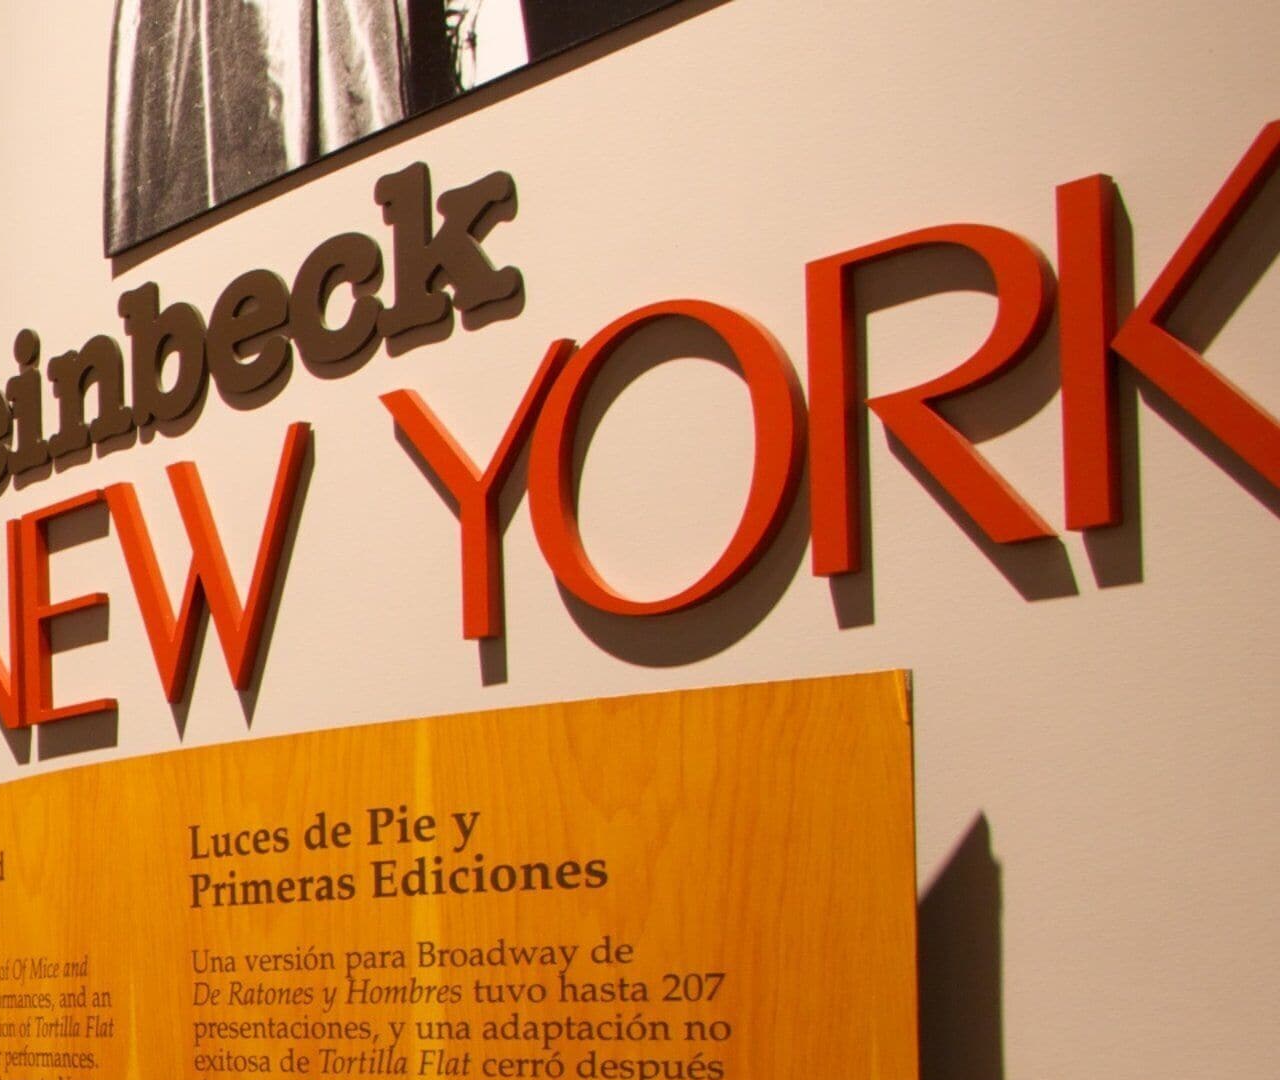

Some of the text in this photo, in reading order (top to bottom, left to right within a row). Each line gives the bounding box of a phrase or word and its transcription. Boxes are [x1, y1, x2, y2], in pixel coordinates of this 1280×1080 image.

[379, 119, 1280, 640] YORK
[188, 805, 480, 860] Luces de Pie y
[190, 854, 608, 908] Primeras Ediciones
[30, 955, 88, 980] Mice and
[192, 935, 633, 976] Una versión para Broadway de
[59, 988, 87, 1008] and
[92, 992, 112, 1008] an
[193, 972, 726, 1012] De Ratones y Hombres tuvo hasta 207
[19, 1017, 114, 1038] of Tortilla Flat
[193, 1012, 731, 1047] presentaciones, y una adaptación no
[4, 1047, 99, 1072] performances.
[194, 1048, 271, 1072] exitosa
[280, 1048, 310, 1074] de
[318, 1044, 408, 1075] Tortilla
[418, 1049, 470, 1077] Flat
[482, 1051, 564, 1080] cerró
